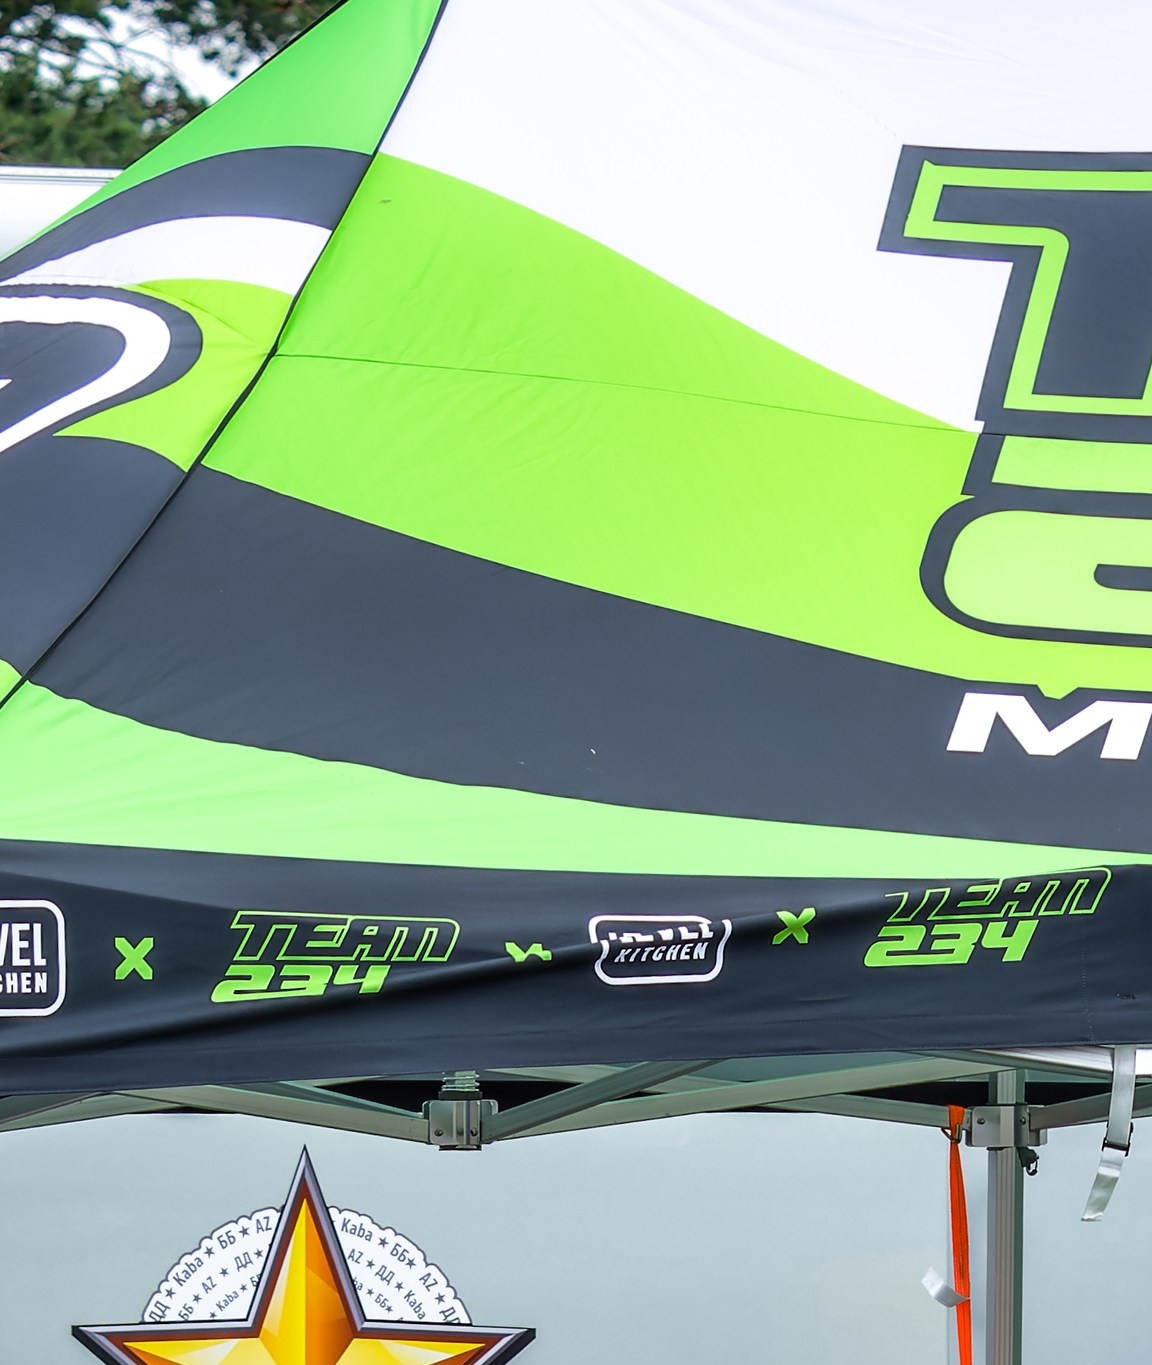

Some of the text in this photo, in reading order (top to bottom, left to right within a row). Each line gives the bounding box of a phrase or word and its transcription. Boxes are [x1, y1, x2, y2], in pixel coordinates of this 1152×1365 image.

[884, 867, 1112, 923] TEAM
[230, 910, 460, 961] TEAM
[864, 919, 1039, 967] 234
[614, 942, 709, 963] KITCHEN
[0, 972, 47, 993] HEN
[210, 964, 391, 1003] 234
[256, 1216, 272, 1233] AZ
[341, 1217, 373, 1241] Kaba
[347, 1249, 364, 1264] AZ
[173, 1257, 204, 1286] Kaba
[419, 1272, 438, 1292] AZ
[201, 1276, 217, 1294] AZ
[216, 1291, 239, 1312] Kaba
[403, 1290, 426, 1320] Kaba
